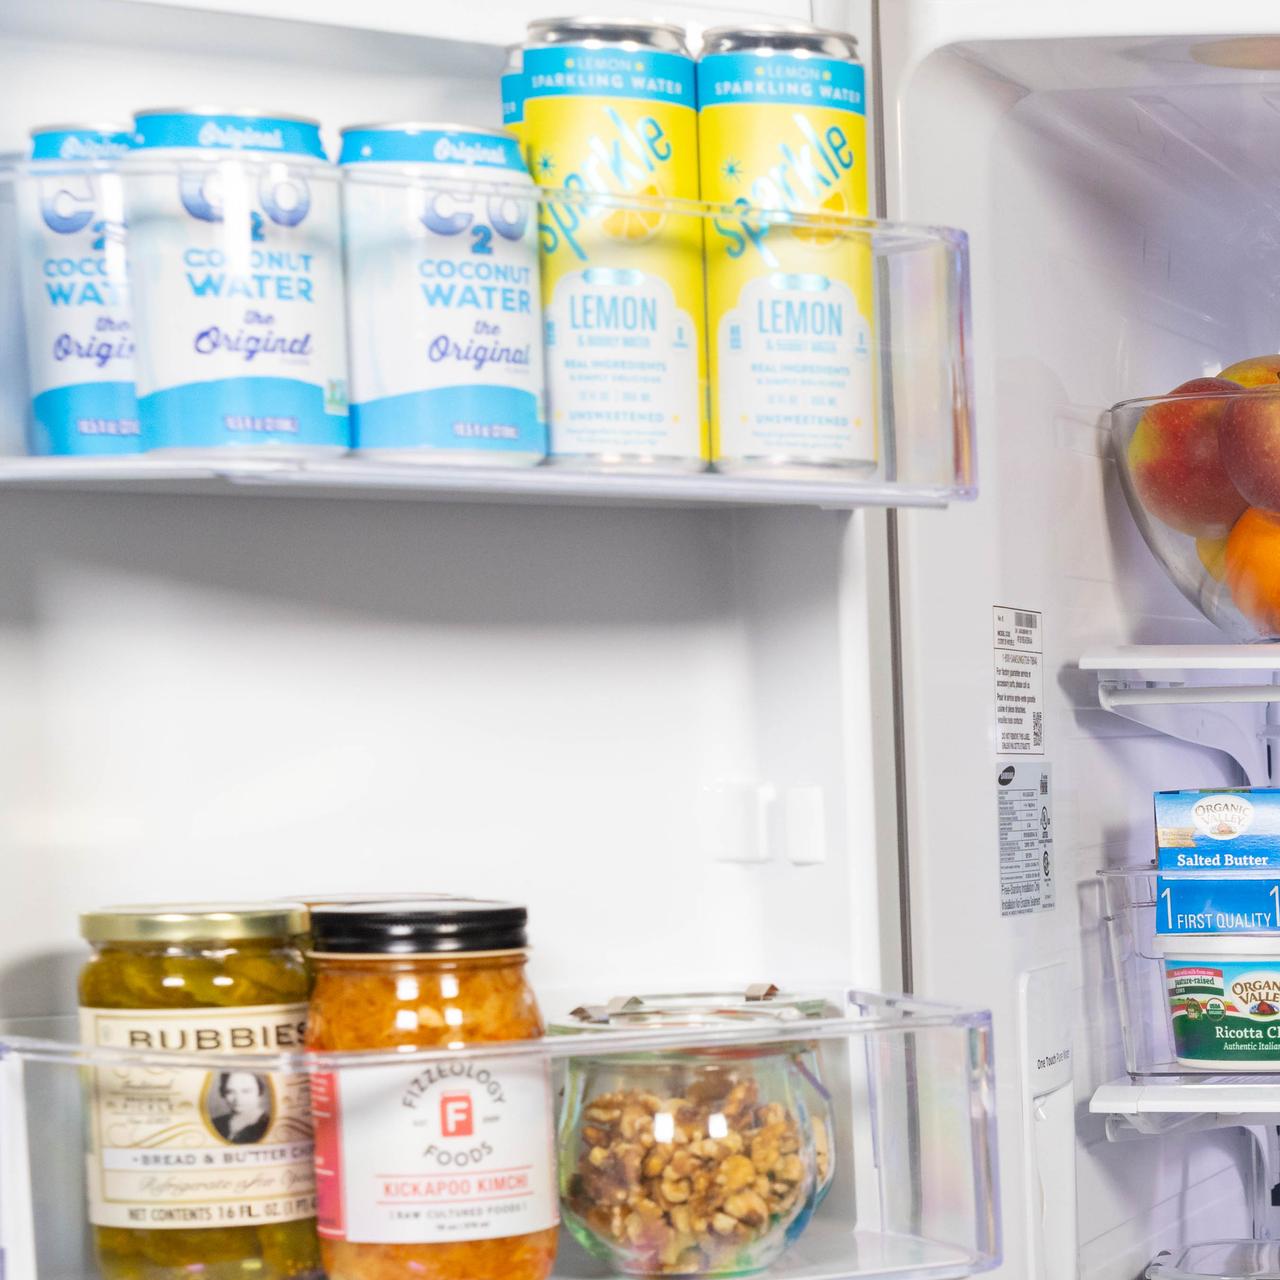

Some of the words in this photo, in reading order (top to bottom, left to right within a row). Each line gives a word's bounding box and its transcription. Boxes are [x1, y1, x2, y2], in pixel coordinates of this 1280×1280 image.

[531, 72, 624, 89] SPARKLING
[631, 76, 682, 95] WATER
[714, 80, 813, 97] SPARKLING
[819, 84, 861, 104] WATER
[535, 106, 673, 261] Sparkle
[712, 114, 855, 268] Sparkle
[418, 259, 530, 285] COCONUT
[420, 283, 531, 314] WATER
[569, 295, 657, 331] LEMON
[757, 300, 843, 336] LEMON
[568, 410, 664, 424] UNSWEETENED
[754, 412, 849, 428] UNSWEETENED
[1177, 854, 1221, 866] Salted
[1224, 854, 1268, 865] Butter
[1161, 888, 1172, 928] 1
[1178, 914, 1212, 928] FIRST
[1216, 913, 1271, 929] QUALITY
[1269, 885, 1280, 927] 1
[1216, 1027, 1263, 1039] Ricotta
[1224, 1042, 1257, 1050] Authentic
[402, 1060, 506, 1110] FIZZEOLOGY
[446, 1101, 469, 1133] F
[141, 1150, 196, 1165] BREAD
[223, 1150, 286, 1164] BUTTER
[423, 1141, 494, 1167] FOODS
[384, 1181, 470, 1197] KICKAPOO
[477, 1175, 528, 1191] KIMCHI
